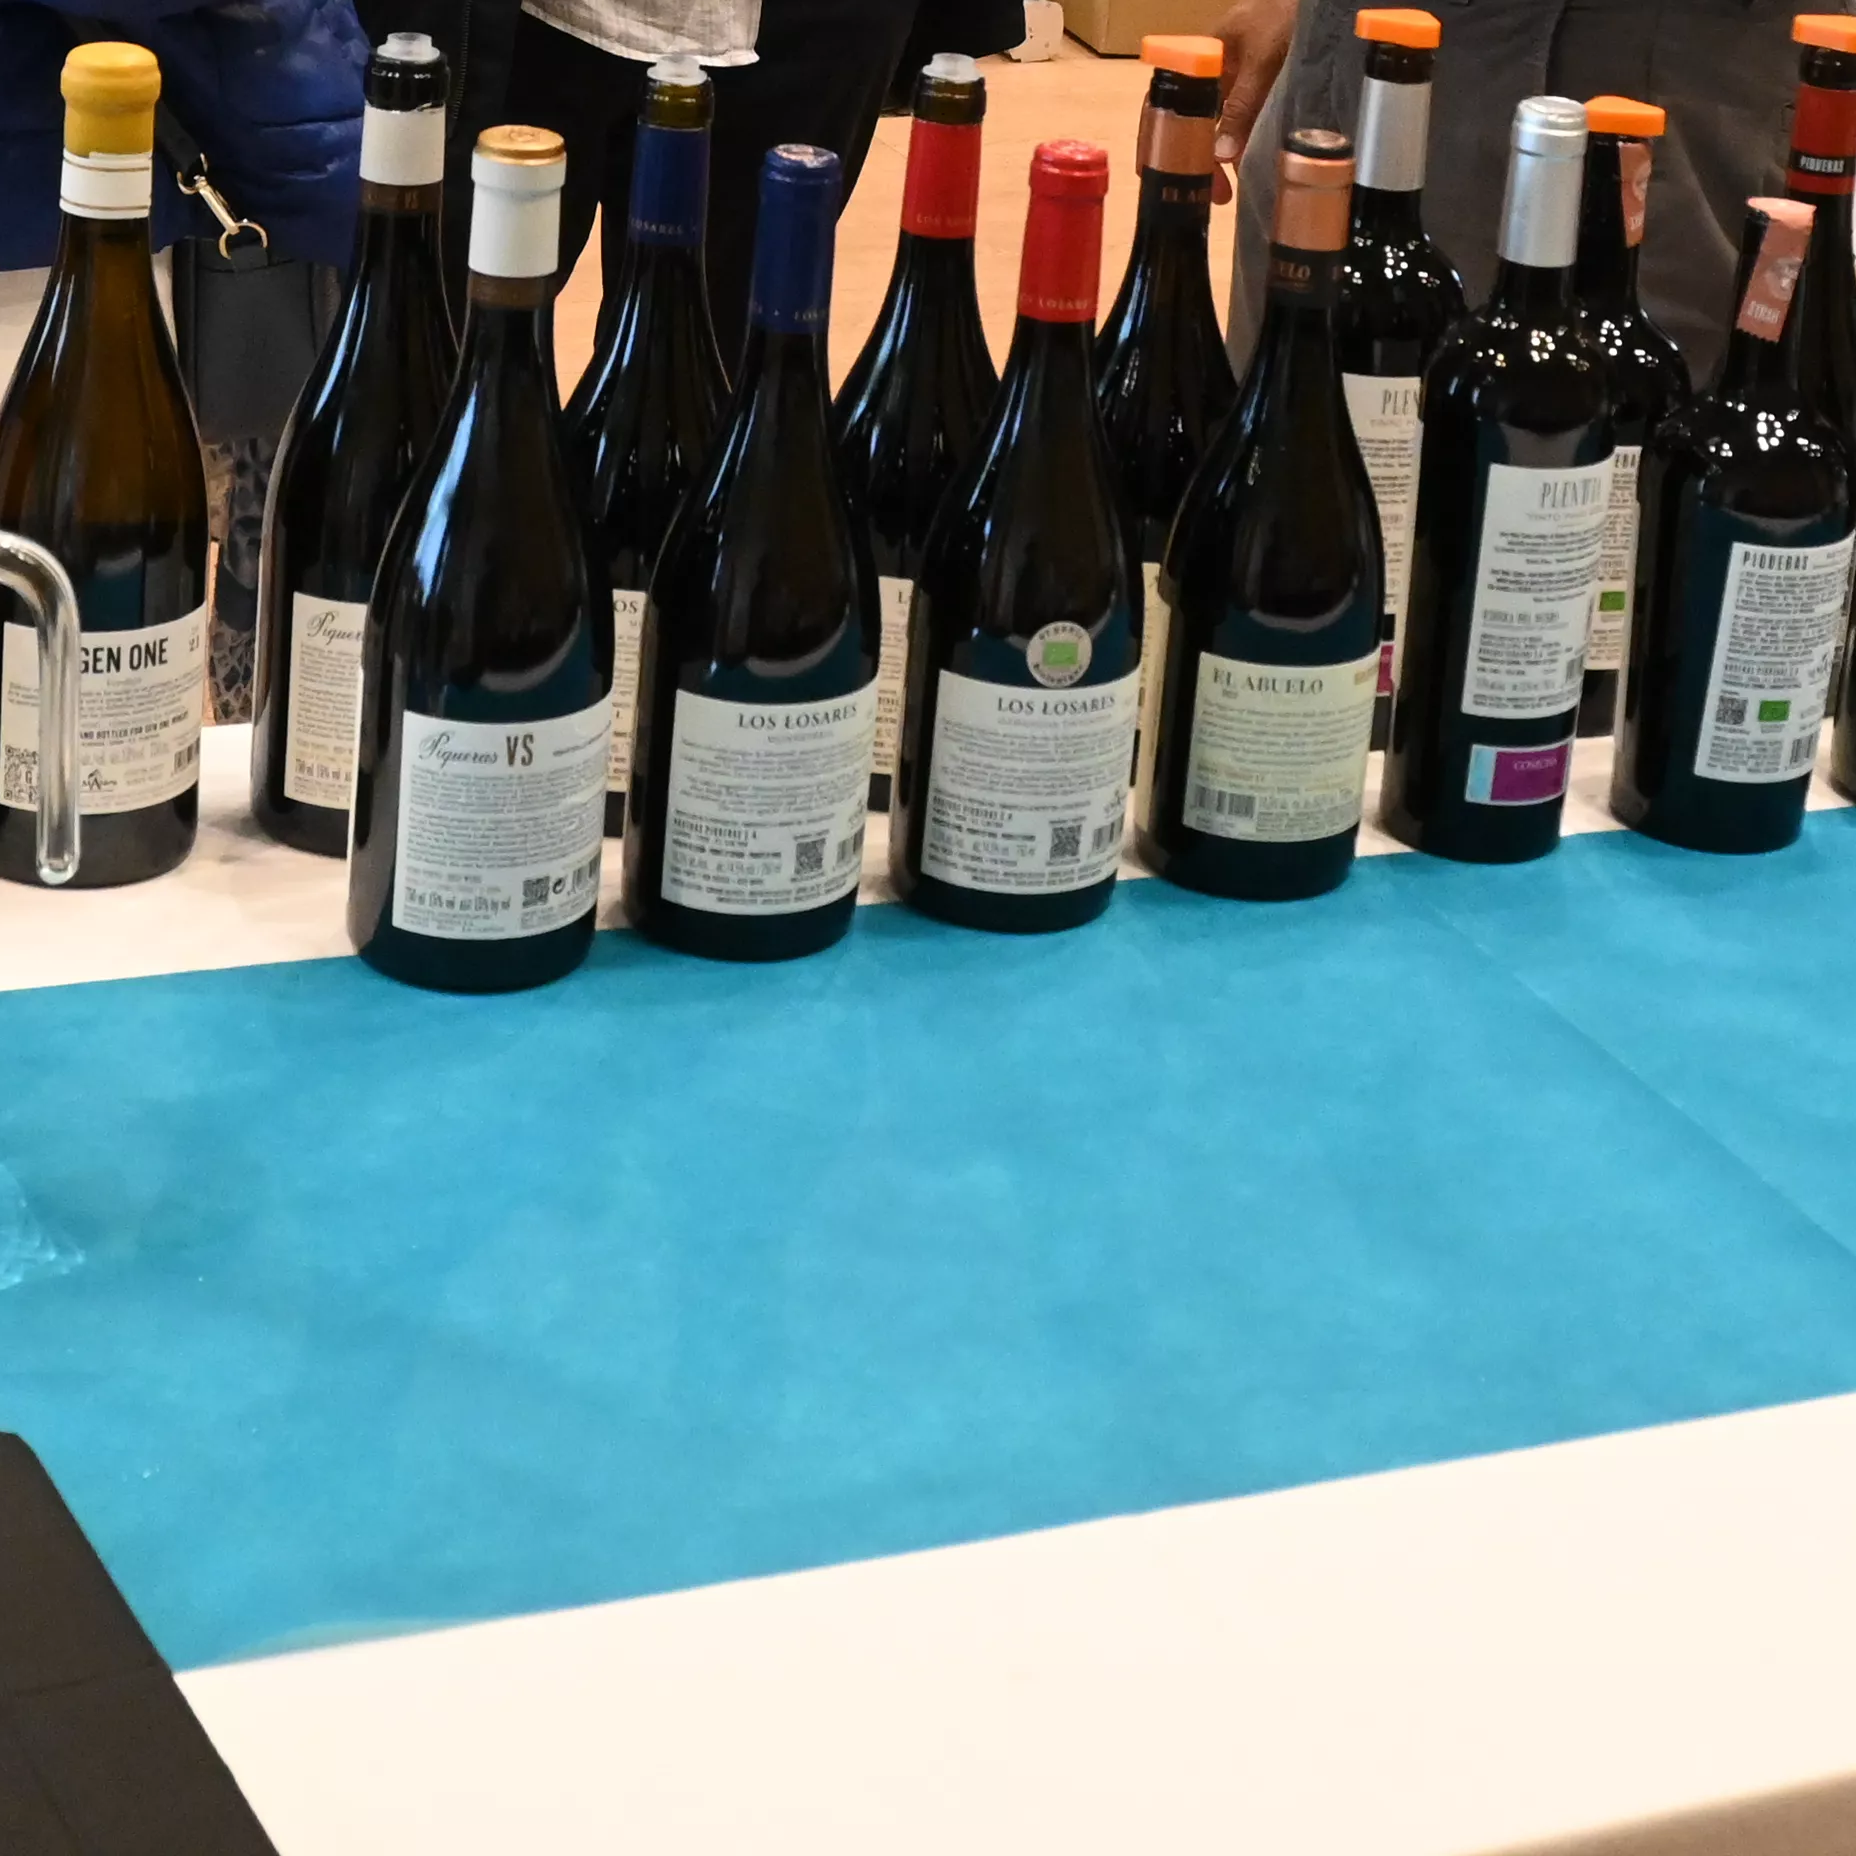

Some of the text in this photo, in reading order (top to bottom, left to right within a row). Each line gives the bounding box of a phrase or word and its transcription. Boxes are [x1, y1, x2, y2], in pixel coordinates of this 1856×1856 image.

[1799, 155, 1846, 173] PIQUERAS
[614, 600, 638, 614] OS
[128, 637, 169, 672] ONE
[1213, 667, 1324, 695] EL ABUELO
[737, 704, 858, 730] LOS LOSARES
[997, 695, 1116, 717] LOS LOSARES
[418, 730, 499, 769] Piqueras
[505, 734, 535, 768] VS
